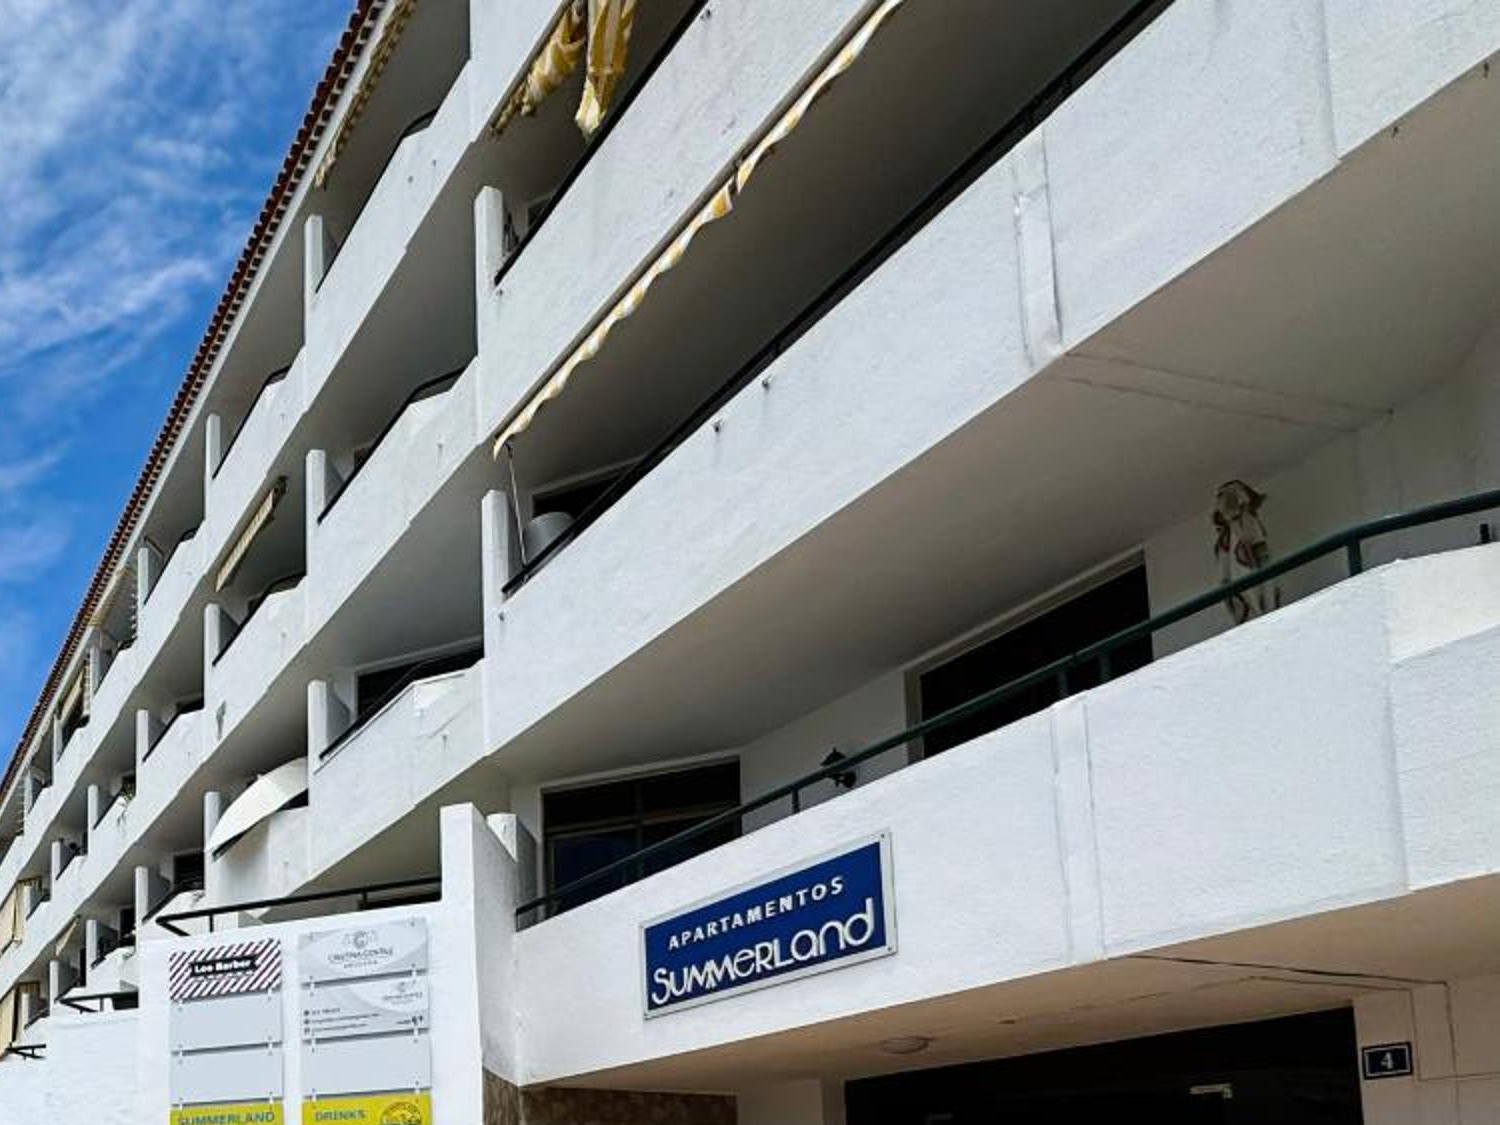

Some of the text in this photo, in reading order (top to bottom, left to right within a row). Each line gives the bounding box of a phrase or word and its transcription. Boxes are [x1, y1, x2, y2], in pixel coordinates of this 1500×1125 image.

[668, 876, 844, 950] APARTAMENTOS
[215, 959, 252, 971] Barber
[1380, 1051, 1394, 1071] 4
[315, 1109, 366, 1121] DRINKS
